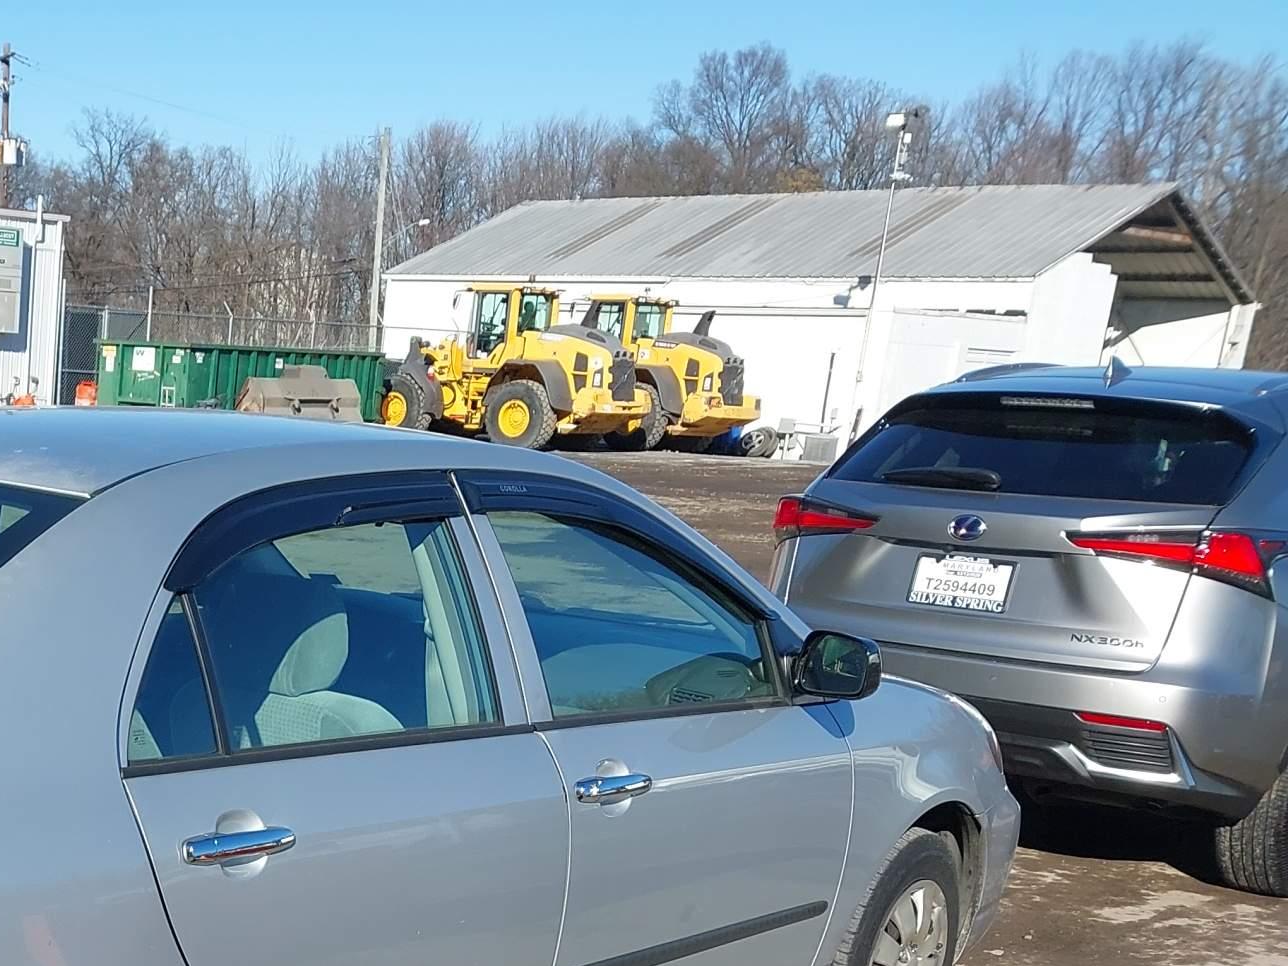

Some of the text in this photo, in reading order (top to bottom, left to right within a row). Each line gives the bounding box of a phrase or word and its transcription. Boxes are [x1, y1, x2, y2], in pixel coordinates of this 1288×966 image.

[943, 562, 999, 574] MARYLAND
[925, 577, 996, 597] T2594409
[908, 590, 1004, 613] SILVER SPRING
